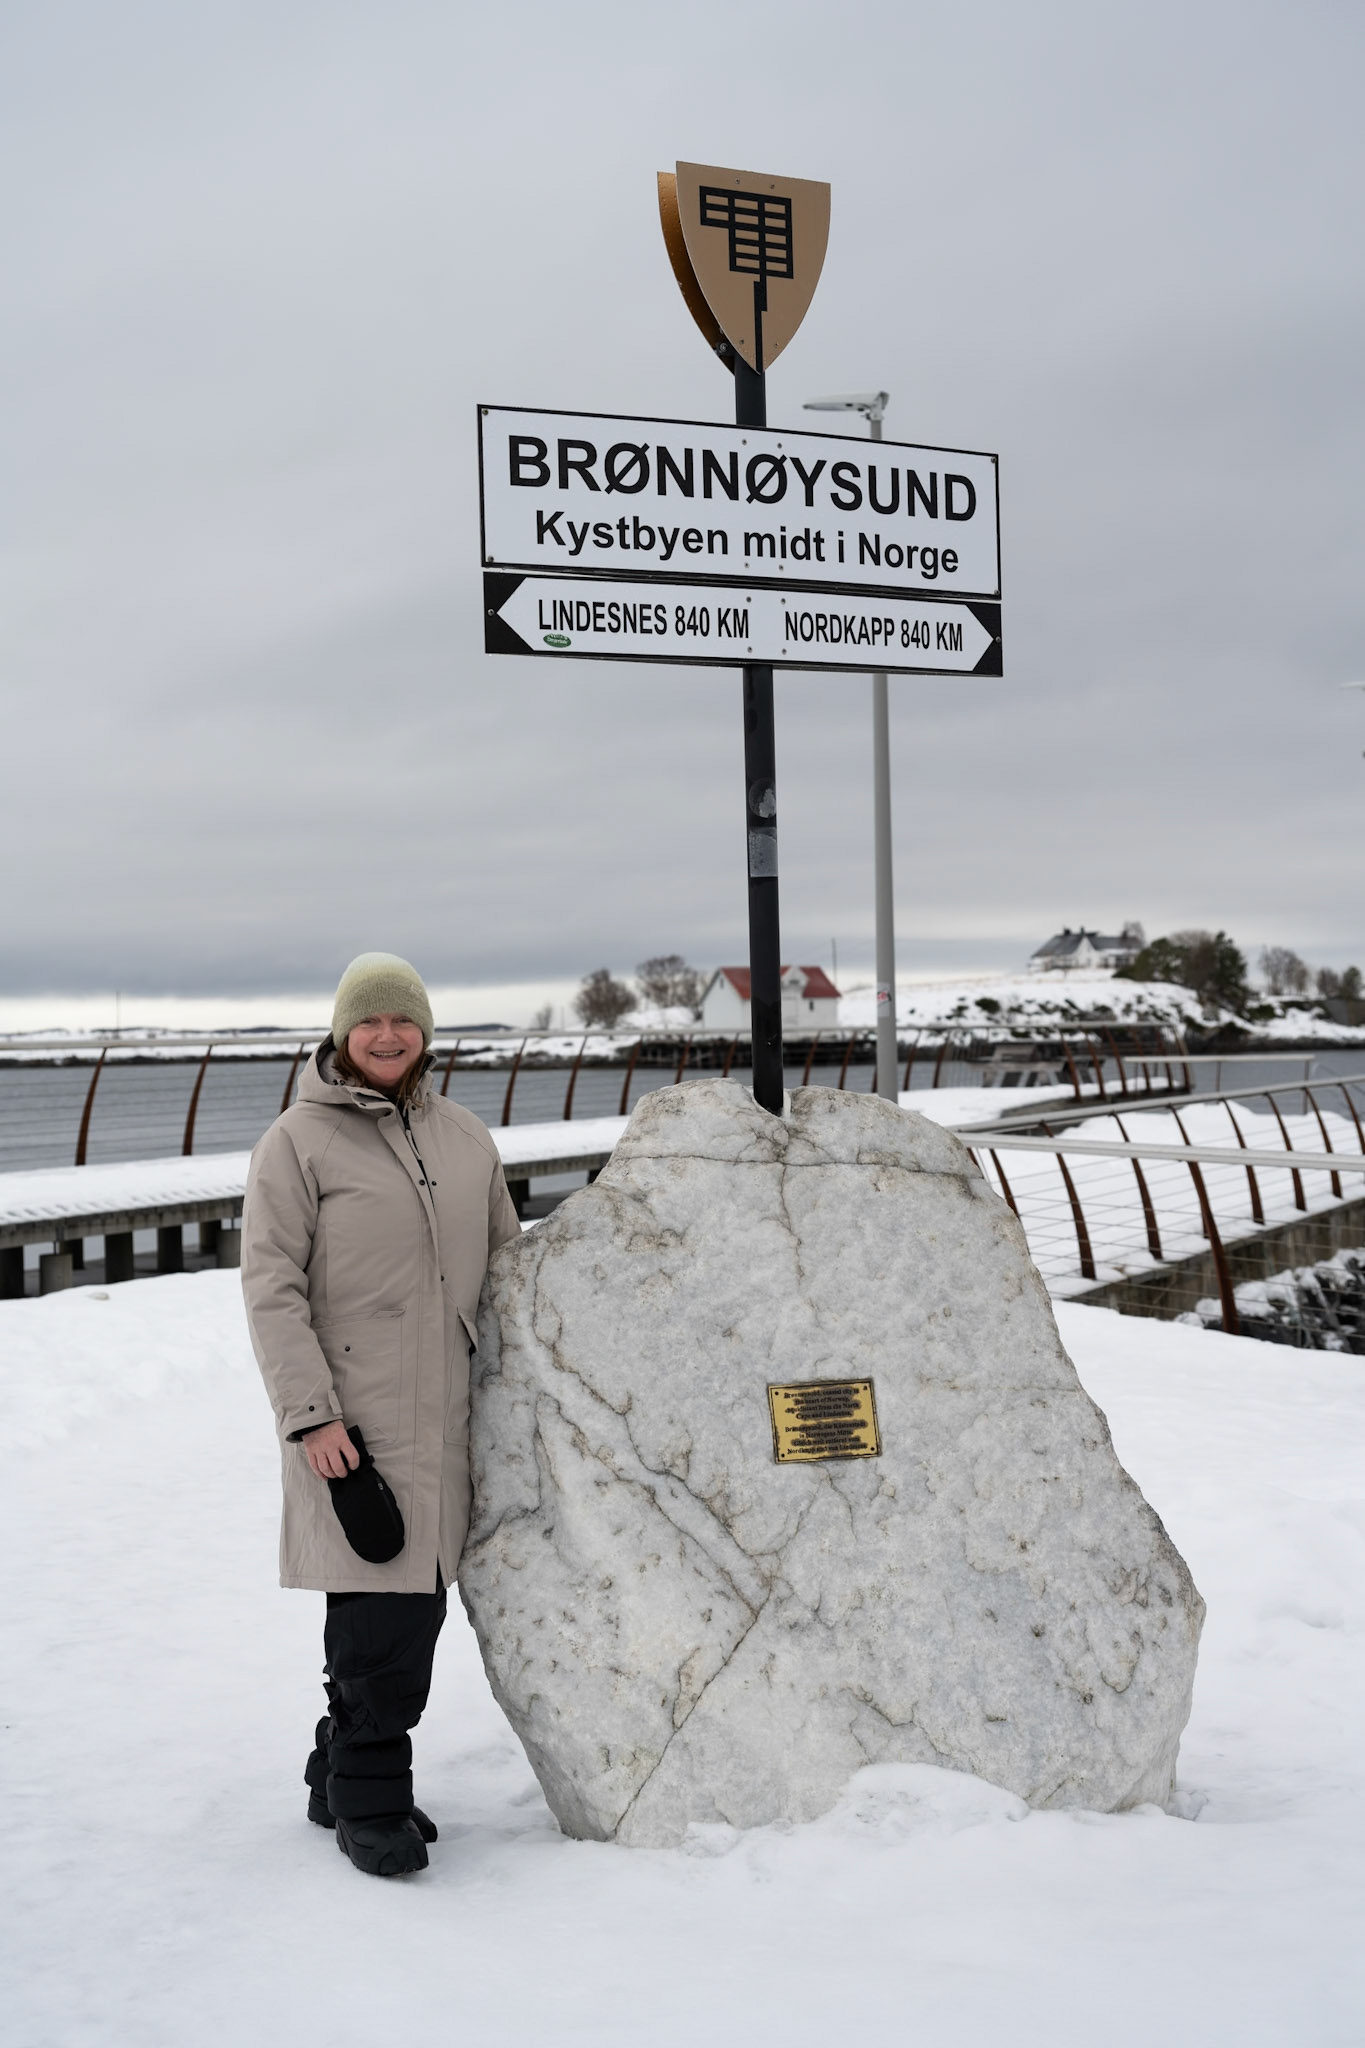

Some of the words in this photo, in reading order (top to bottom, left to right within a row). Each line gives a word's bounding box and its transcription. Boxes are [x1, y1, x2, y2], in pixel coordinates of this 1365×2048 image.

[508, 434, 977, 522] BRØNNØYSUND
[535, 509, 729, 561] Kystbyen
[743, 525, 826, 562] midt
[837, 530, 845, 563] i
[858, 532, 959, 580] Norge
[538, 599, 668, 635] LINDESNES
[674, 605, 710, 637] 840
[717, 607, 749, 639] KM
[784, 610, 895, 647] NORDKAPP
[900, 619, 931, 650] 840
[936, 621, 963, 652] KM
